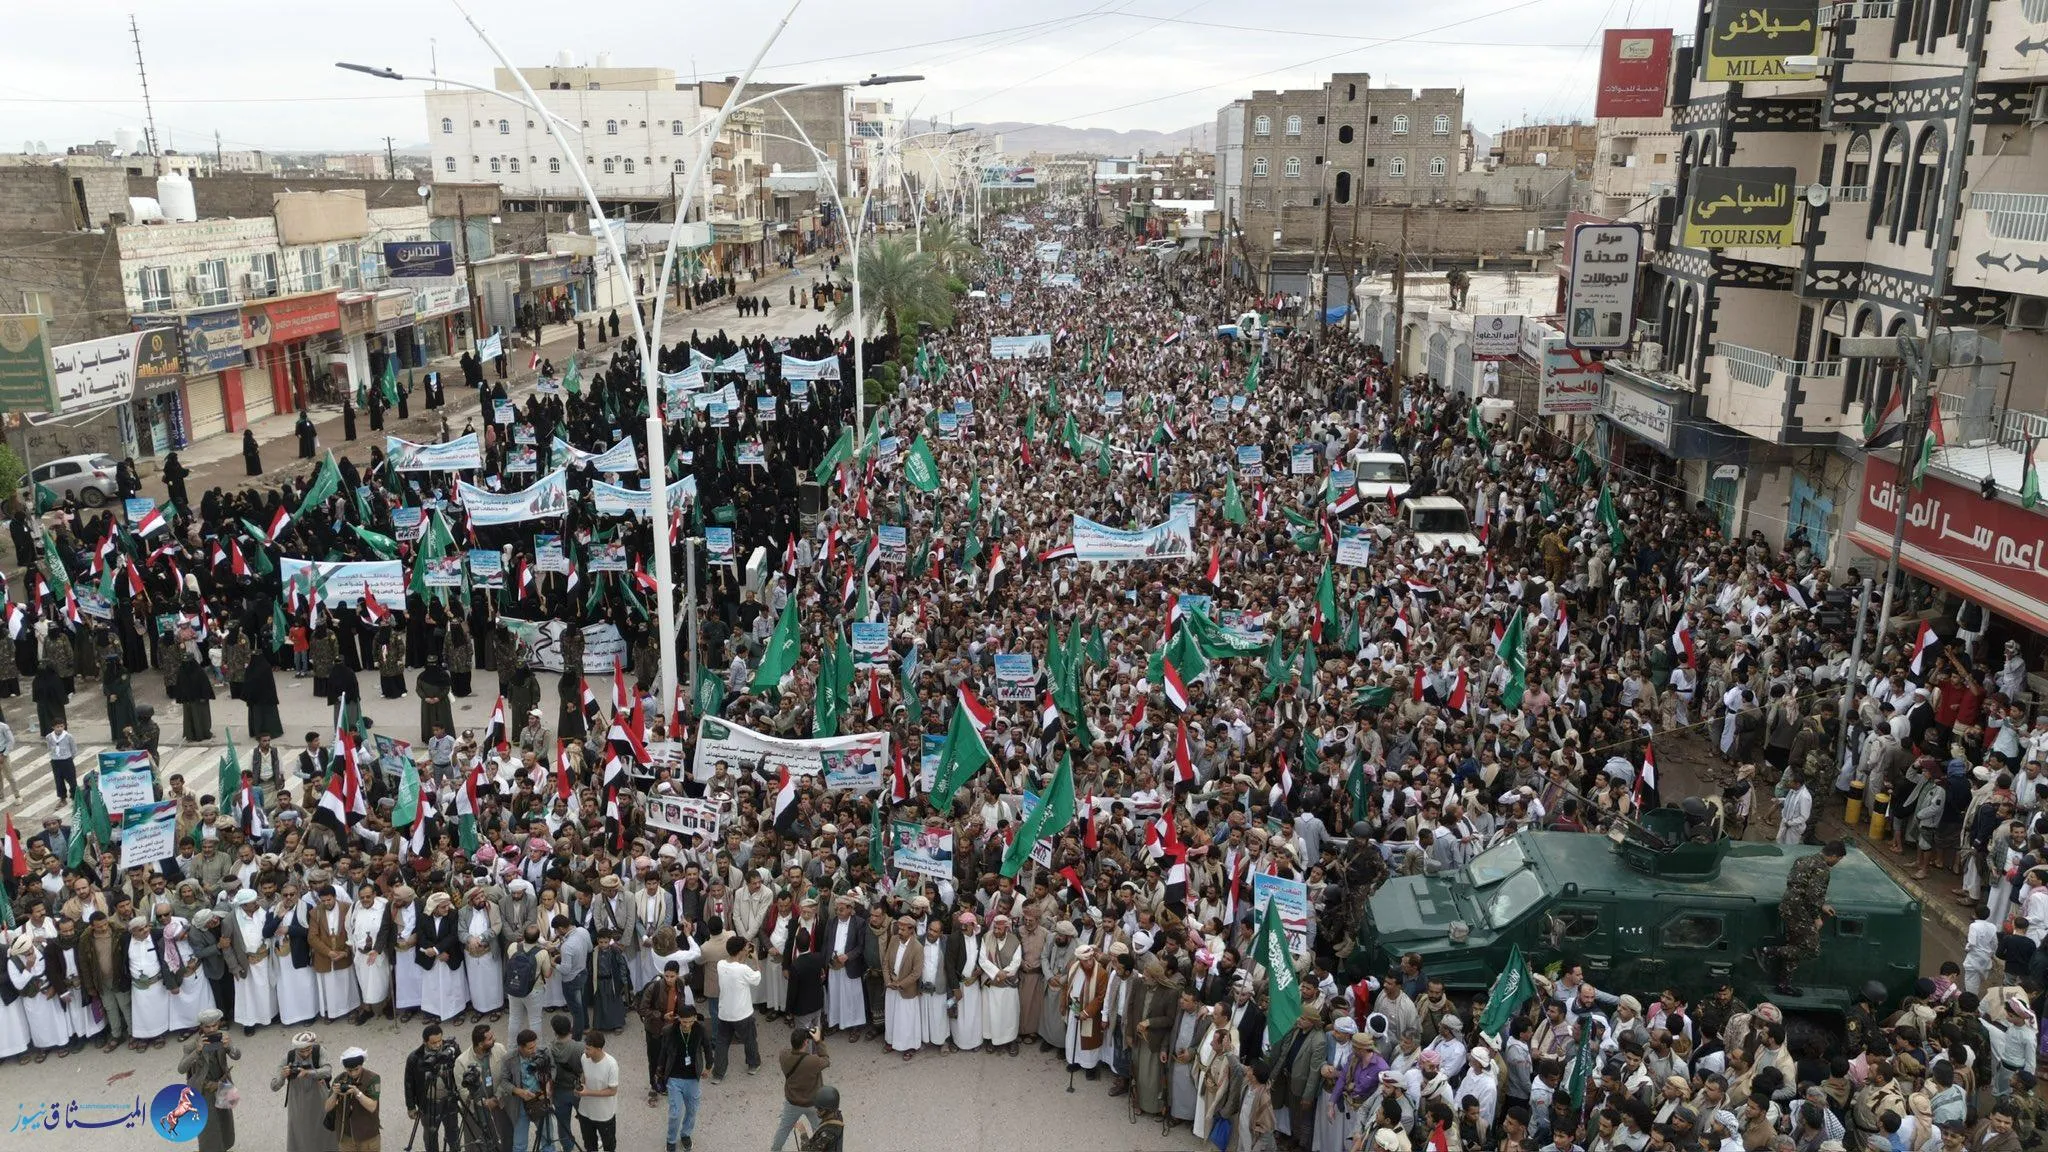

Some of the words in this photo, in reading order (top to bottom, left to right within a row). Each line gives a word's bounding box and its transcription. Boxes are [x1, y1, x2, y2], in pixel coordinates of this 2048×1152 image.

[1720, 8, 1811, 40] ميلانو
[1726, 59, 1793, 77] MILAN
[1697, 183, 1787, 219] السياحي
[1700, 229, 1783, 245] TOURISM
